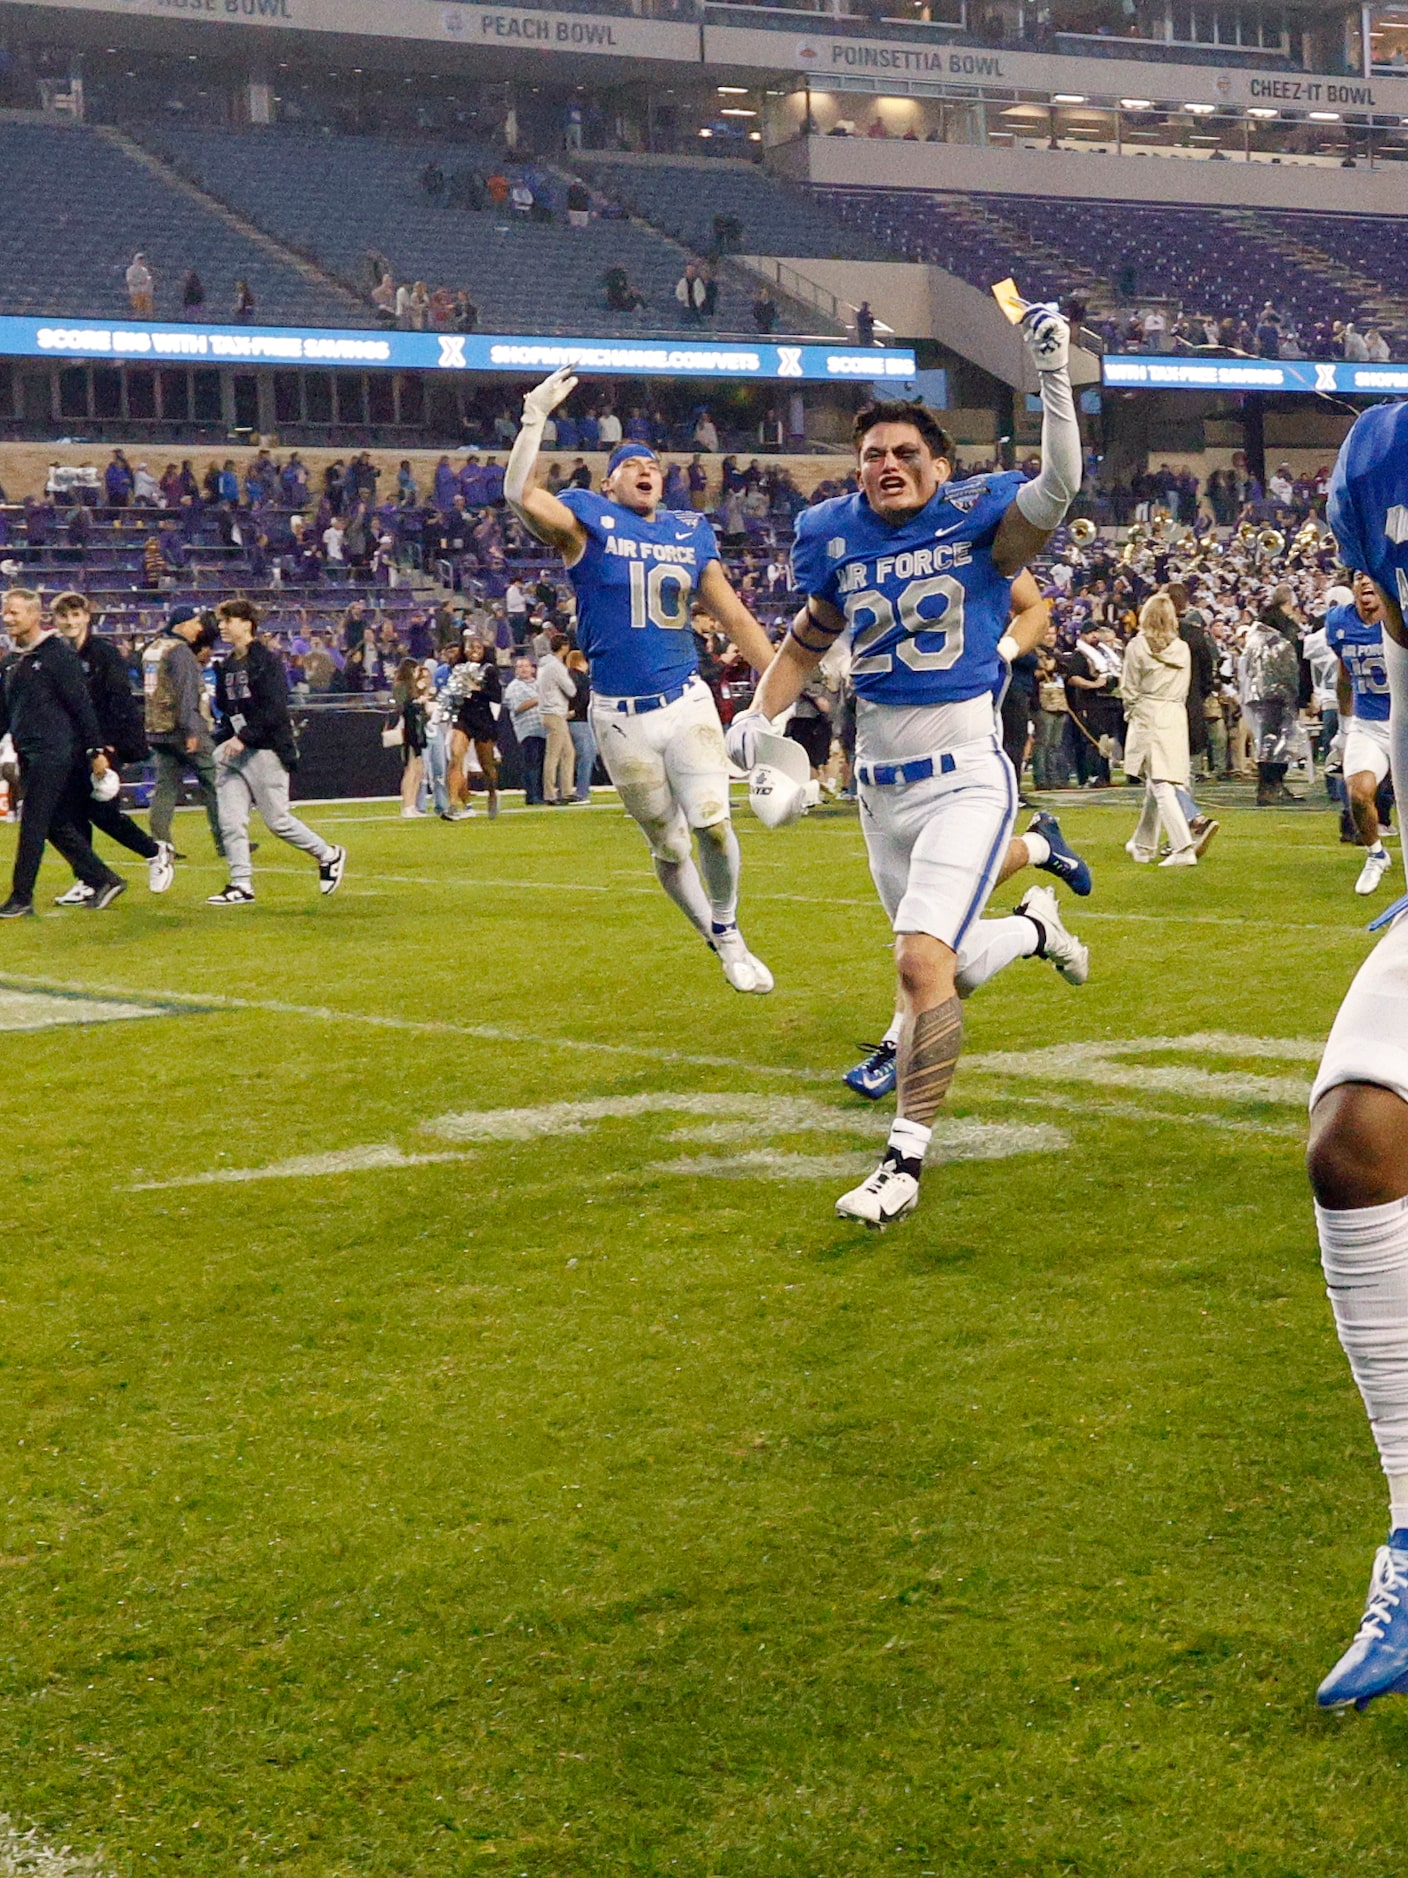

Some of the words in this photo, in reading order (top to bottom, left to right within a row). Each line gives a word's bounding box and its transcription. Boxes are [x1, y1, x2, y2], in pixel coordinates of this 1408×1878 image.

[226, 0, 292, 19] BOWL
[481, 15, 549, 40] PEACH
[556, 22, 617, 46] BOWL
[831, 45, 943, 71] POINSETTIA
[949, 54, 1004, 77] BOWL
[1250, 78, 1322, 101] CHEEZ-IT
[1327, 85, 1377, 106] BOWL
[36, 327, 111, 351] SCORE
[151, 332, 208, 354] WITH
[208, 335, 302, 358] TAX-FREE
[303, 338, 391, 360] SAVINGS
[826, 356, 885, 375] SCORE
[1104, 364, 1147, 382] WITH
[1218, 367, 1284, 385] SAVINGS
[604, 535, 638, 559] AIR
[639, 542, 697, 566] FORCE
[876, 541, 973, 584] FORCE
[629, 560, 693, 630] 10
[843, 574, 966, 676] 29
